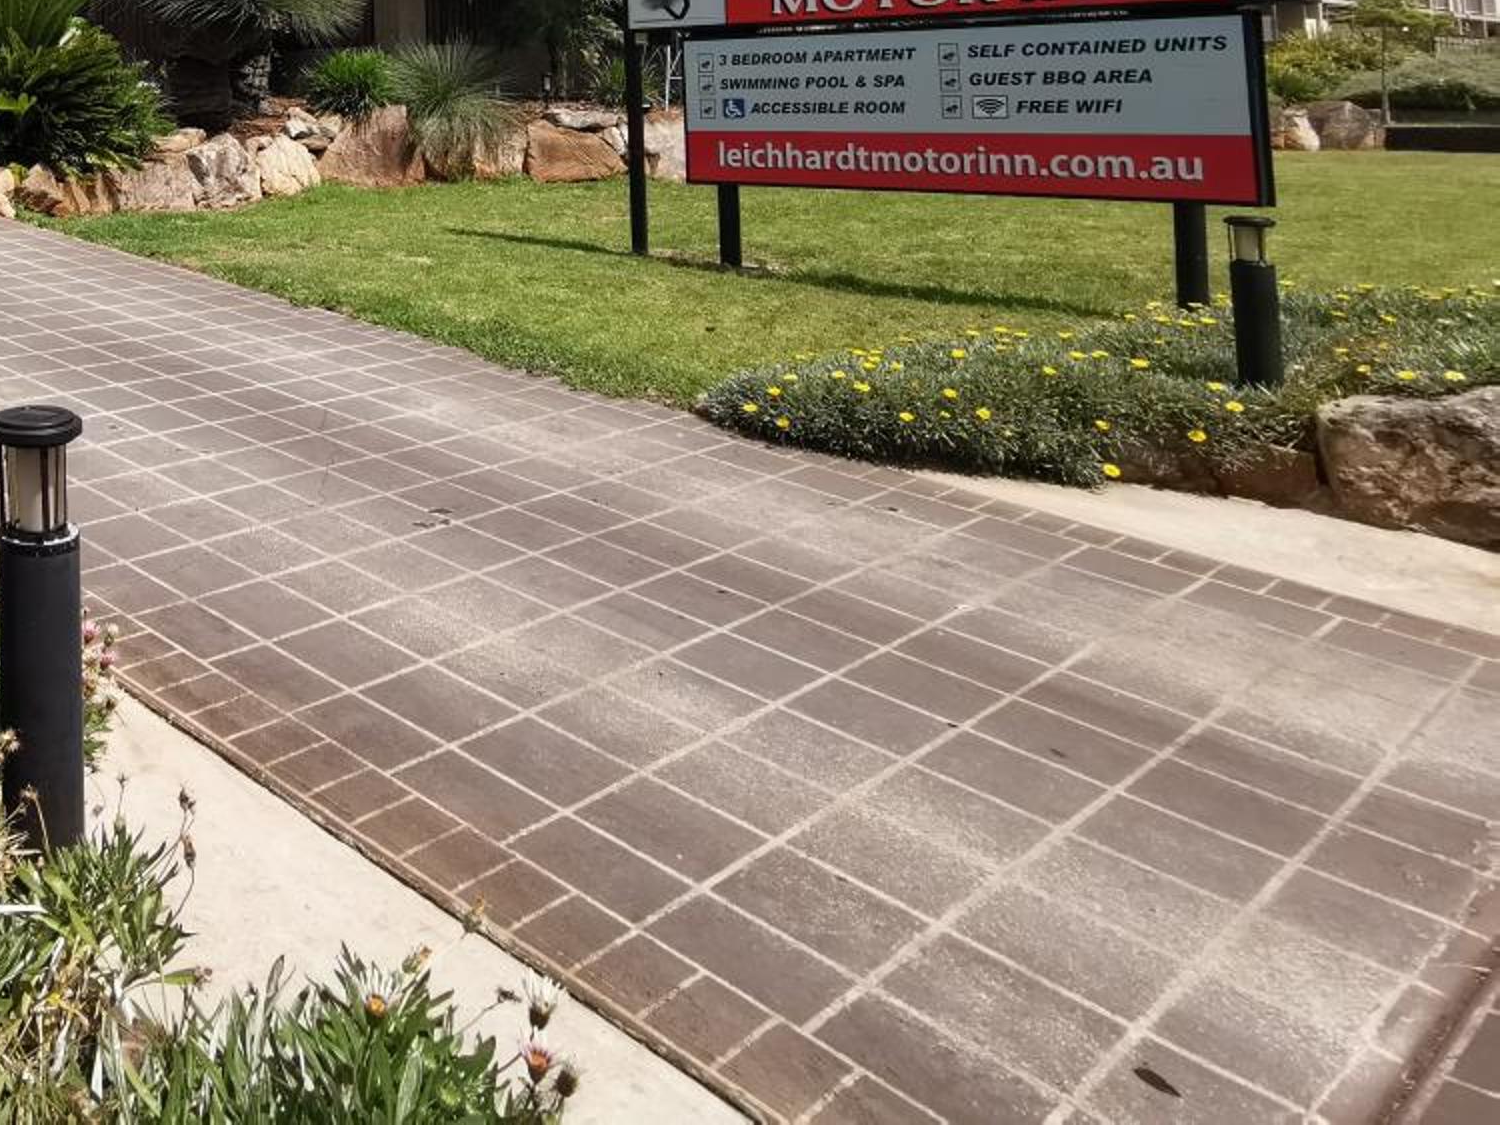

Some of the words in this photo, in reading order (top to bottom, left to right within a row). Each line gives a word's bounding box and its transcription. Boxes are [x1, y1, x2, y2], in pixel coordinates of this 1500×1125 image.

[967, 44, 1015, 58] SELF
[1021, 38, 1146, 56] CONTAINED
[1153, 35, 1228, 52] UNITS
[719, 54, 727, 66] 3
[731, 51, 807, 66] BEDROOM
[812, 47, 916, 63] APARTMENT
[720, 77, 799, 90] SWIMMING
[805, 76, 848, 89] POOL
[855, 76, 866, 88] &
[873, 74, 905, 88] SPA
[969, 71, 1036, 87] GUEST
[1042, 70, 1087, 86] BBQ
[1093, 69, 1153, 84] AREA
[750, 102, 849, 114] ACCESSIBLE
[854, 101, 905, 114] ROOM
[1016, 100, 1069, 114] FREE
[1076, 99, 1123, 114] WIFI
[718, 141, 1204, 181] leichhardtmotorinn.com.au
